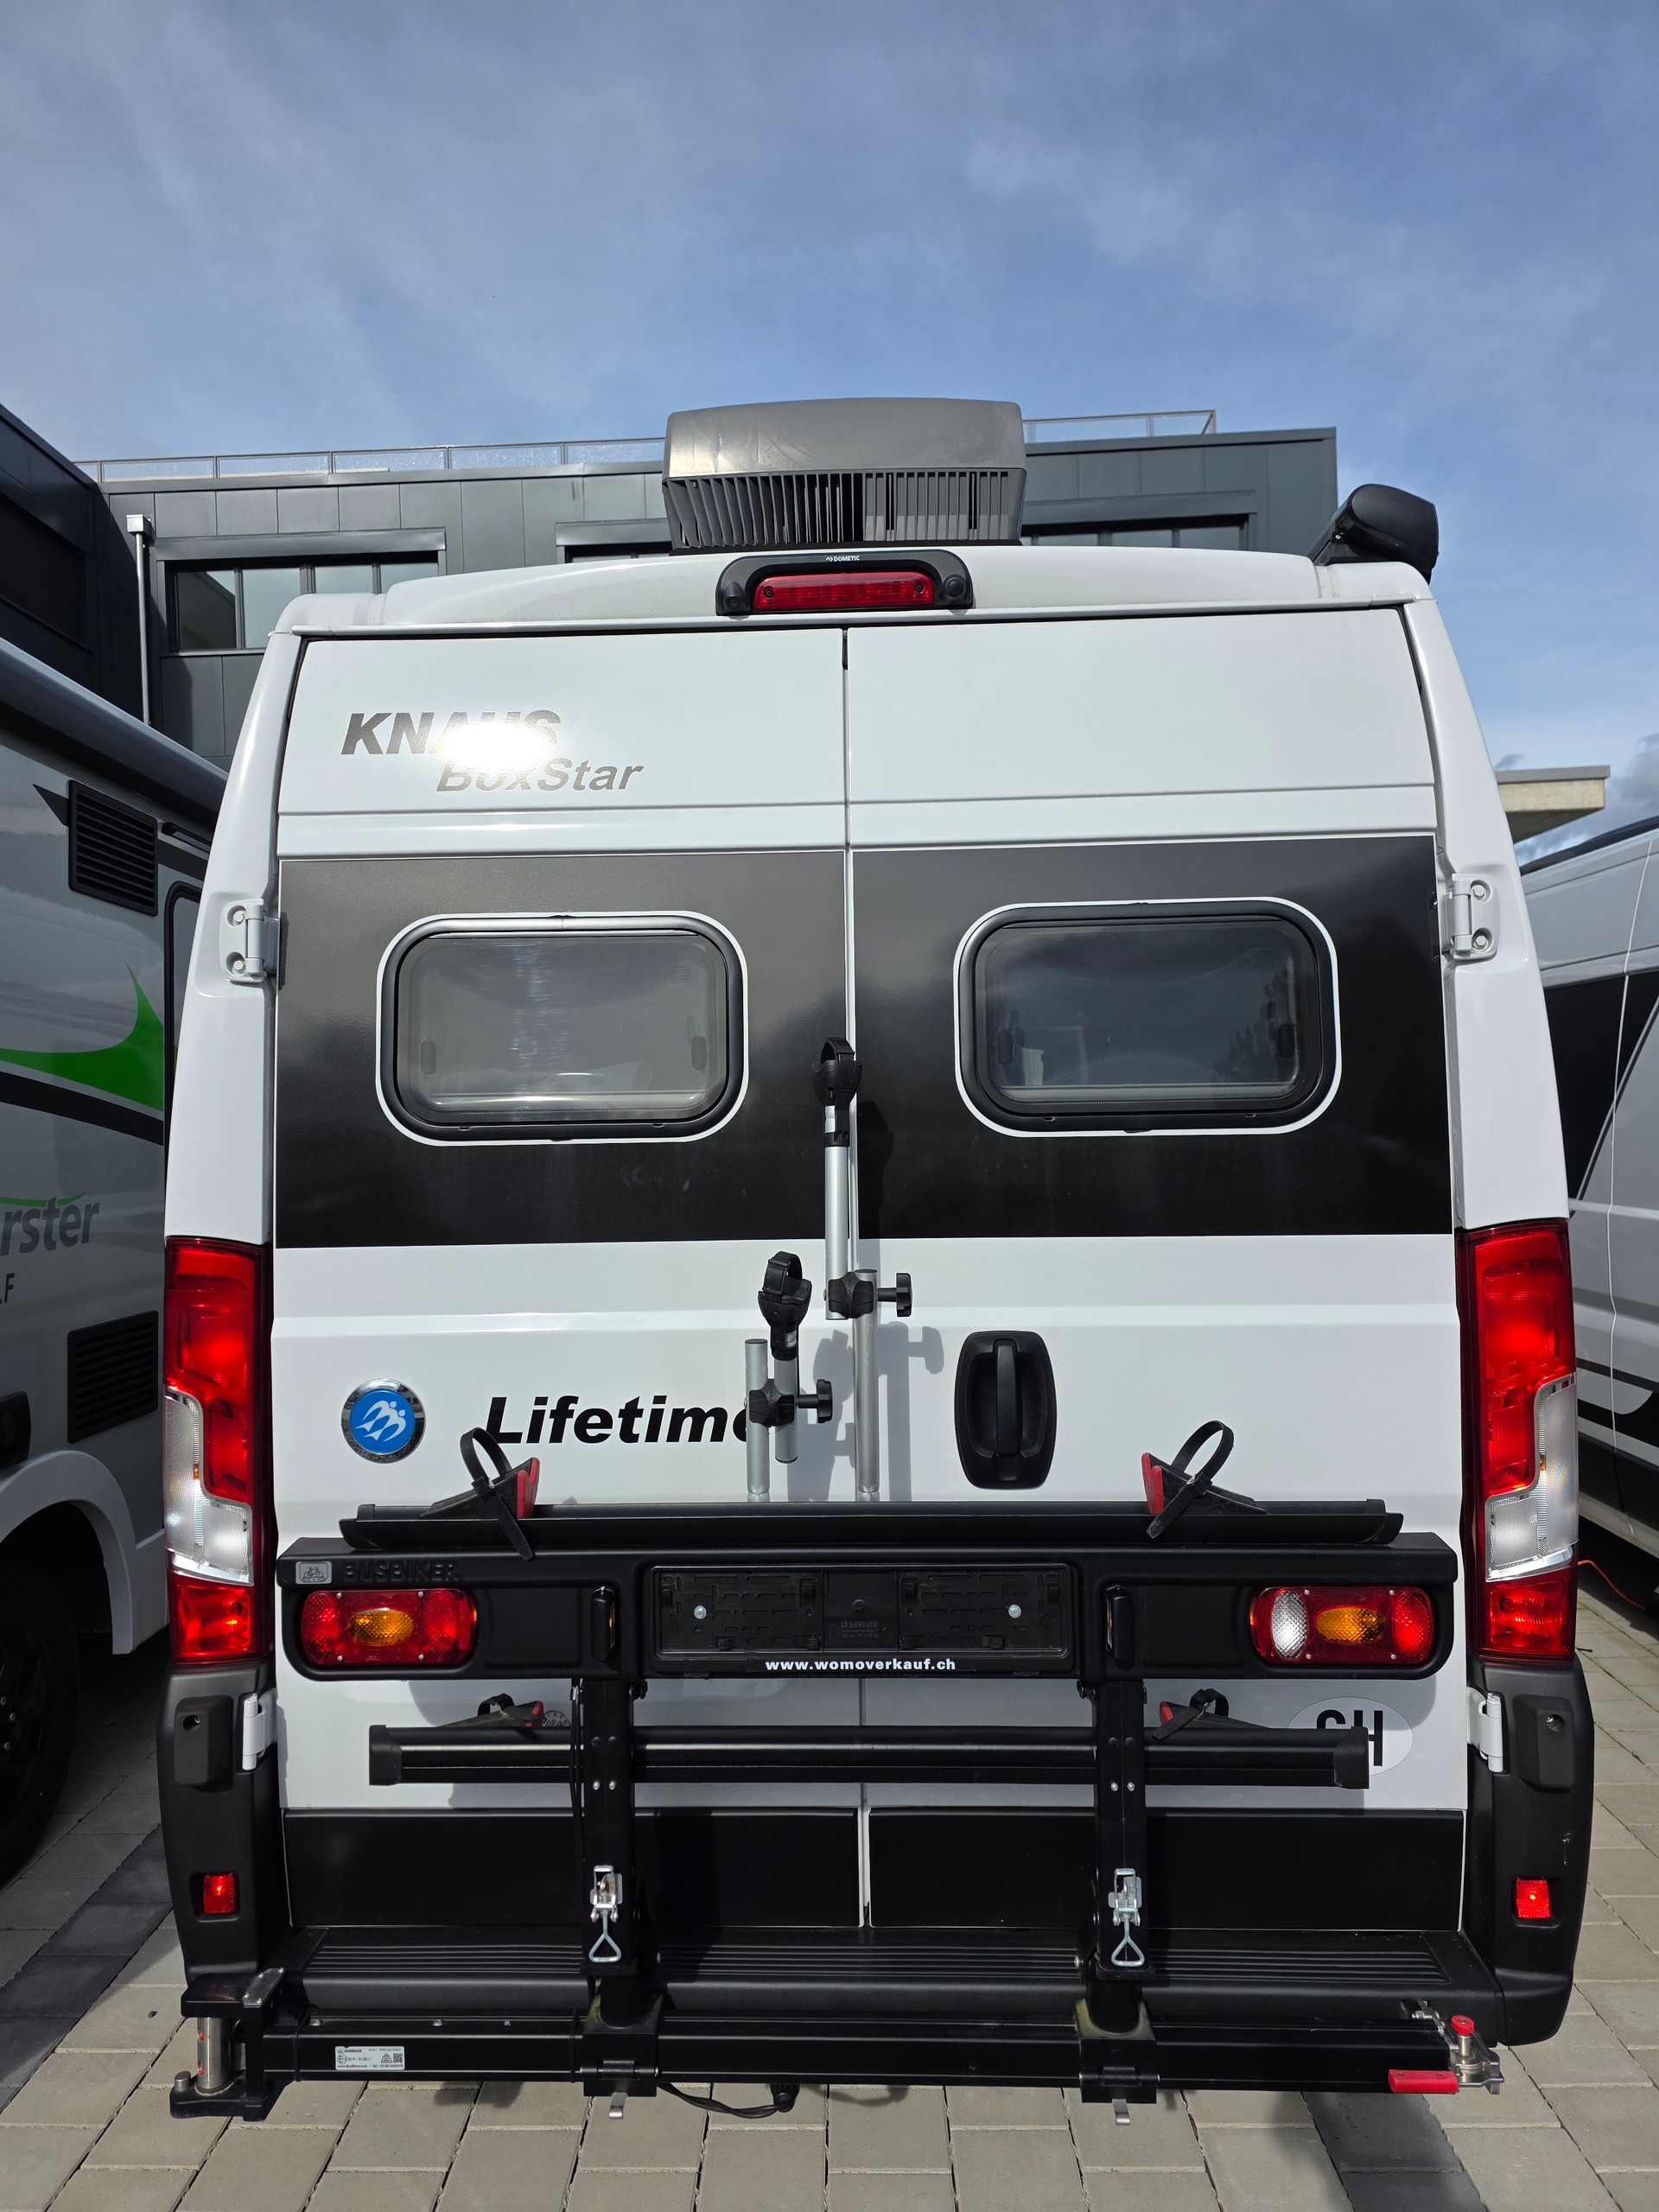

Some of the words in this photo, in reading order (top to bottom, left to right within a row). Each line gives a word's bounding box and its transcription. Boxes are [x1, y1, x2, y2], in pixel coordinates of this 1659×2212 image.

[340, 710, 562, 756] KNS
[436, 758, 645, 792] BoxStar
[0, 1196, 100, 1256] rster
[343, 1560, 460, 1582] BUSBIKER
[765, 1658, 957, 1670] www.womoverkauf.ch
